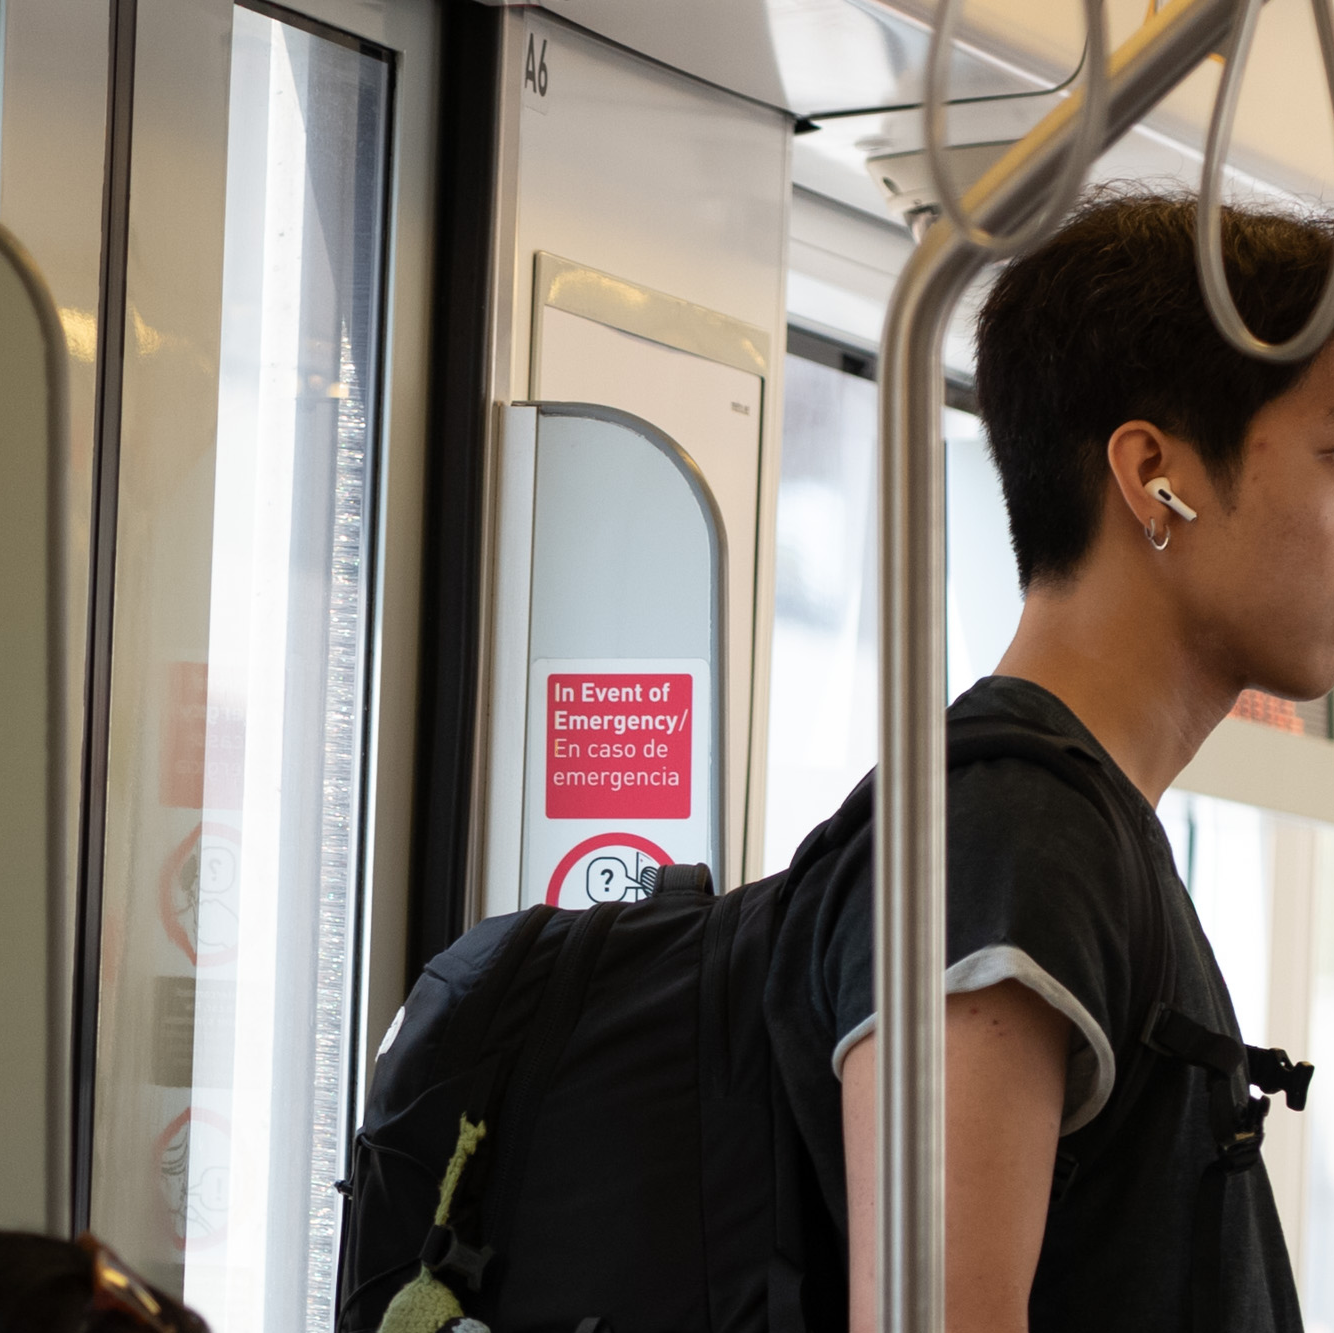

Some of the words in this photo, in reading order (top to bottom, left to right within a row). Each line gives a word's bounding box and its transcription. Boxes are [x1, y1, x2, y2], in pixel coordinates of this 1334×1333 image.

[524, 32, 548, 97] A6
[554, 682, 574, 702] In
[581, 682, 643, 702] Event
[648, 682, 670, 702] of
[554, 708, 688, 735] Emergency/
[554, 738, 580, 758] En
[587, 742, 636, 758] caso
[643, 738, 668, 758] de
[553, 766, 680, 791] emergencia
